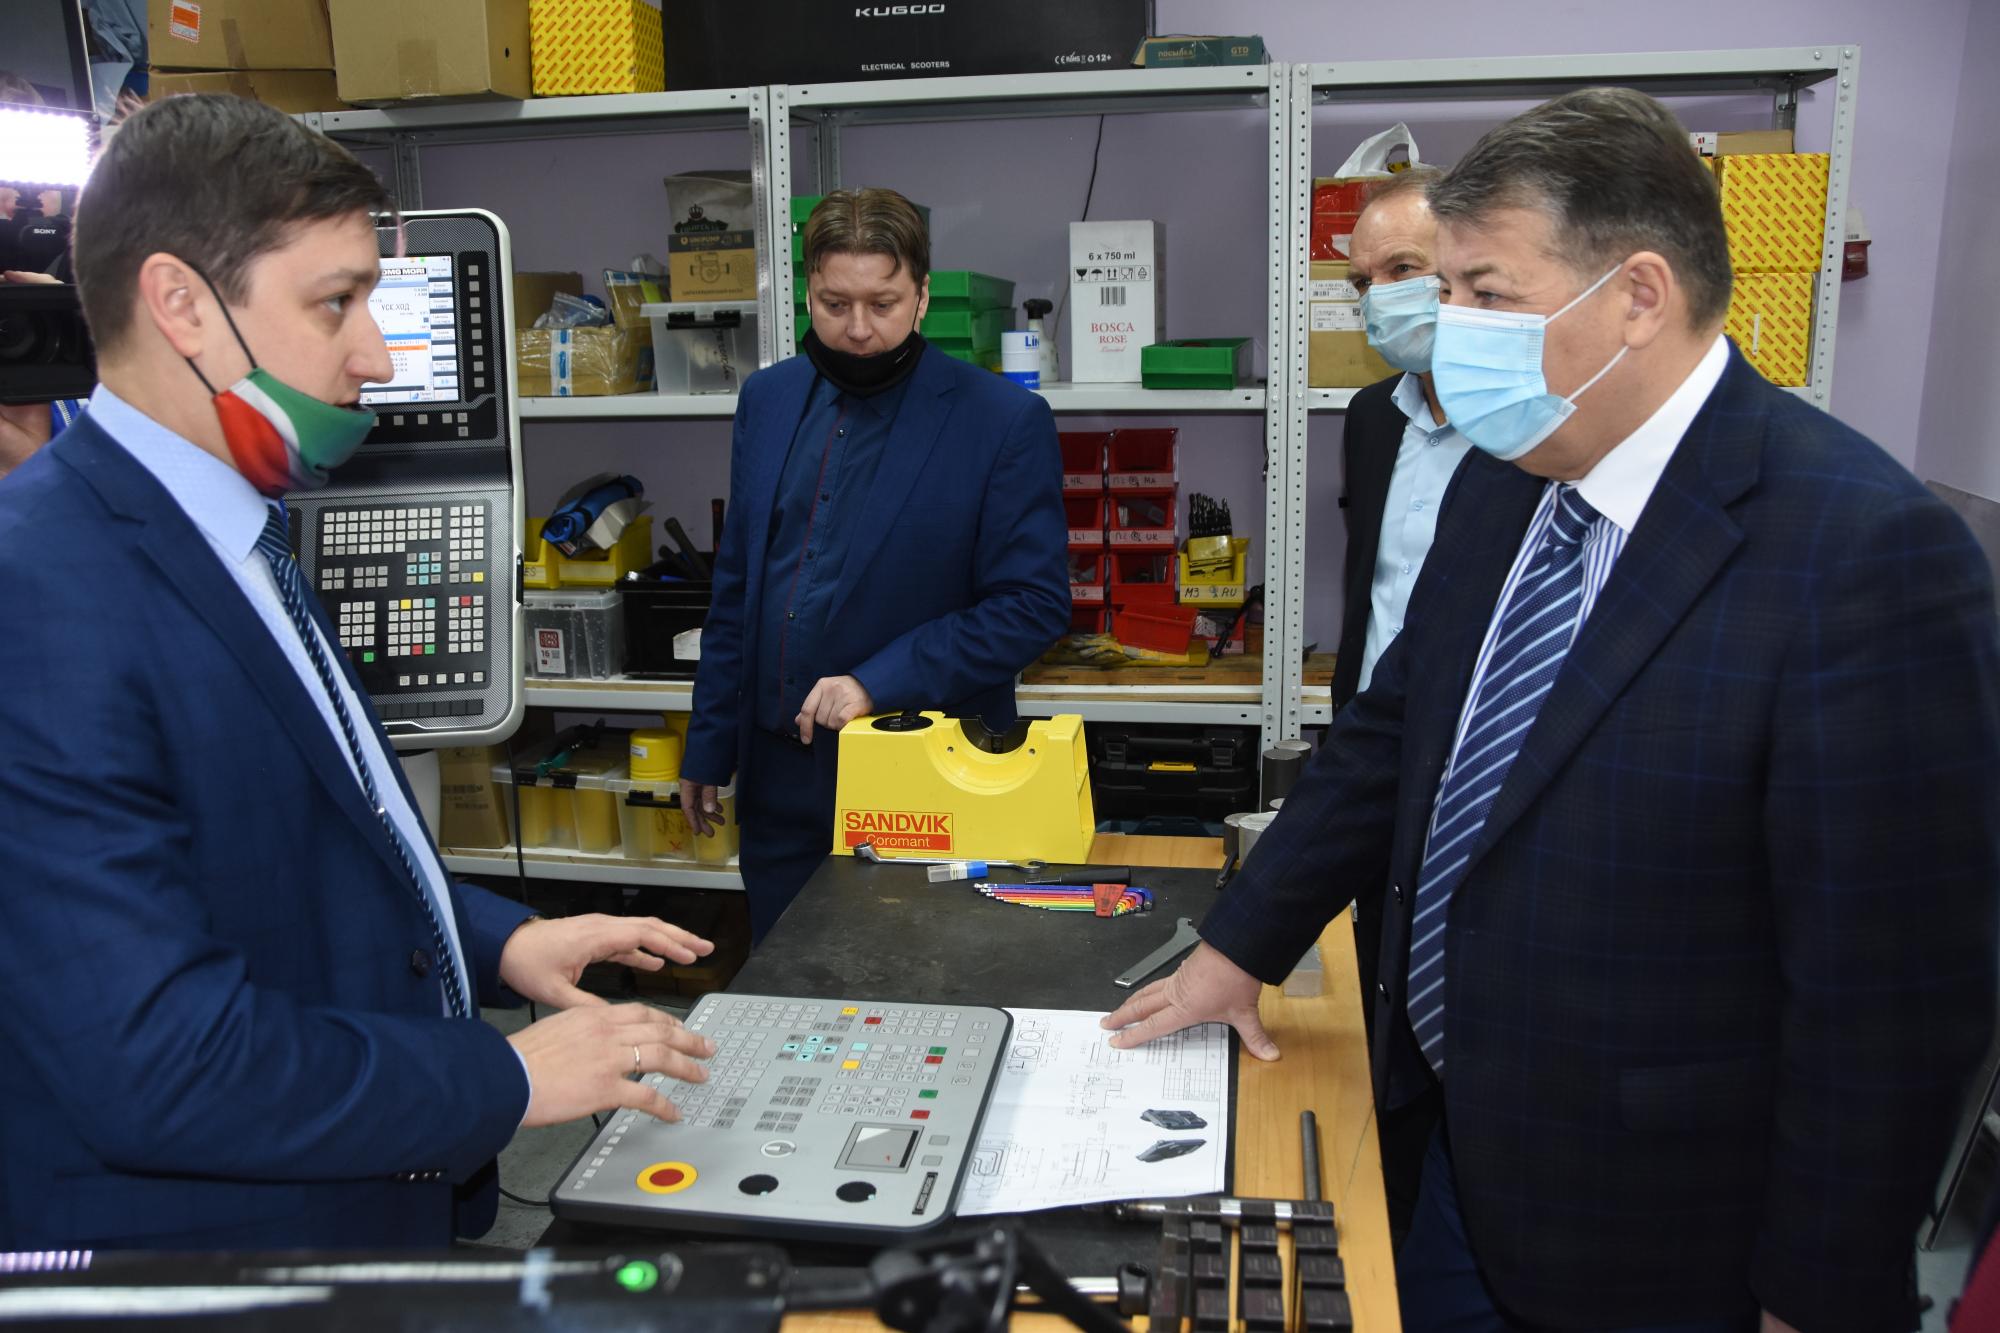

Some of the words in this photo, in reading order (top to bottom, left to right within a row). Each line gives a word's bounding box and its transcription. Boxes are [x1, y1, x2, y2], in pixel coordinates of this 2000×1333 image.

[855, 4, 945, 17] KUGOO
[861, 62, 906, 71] ELECTRICAL
[910, 60, 950, 70] SCOOTERS
[1088, 252, 1095, 261] 6
[1104, 252, 1121, 260] 750
[1123, 251, 1136, 260] ml
[1091, 322, 1135, 333] BOSCA
[845, 811, 950, 833] SANDVIK
[866, 833, 930, 848] Coromant
